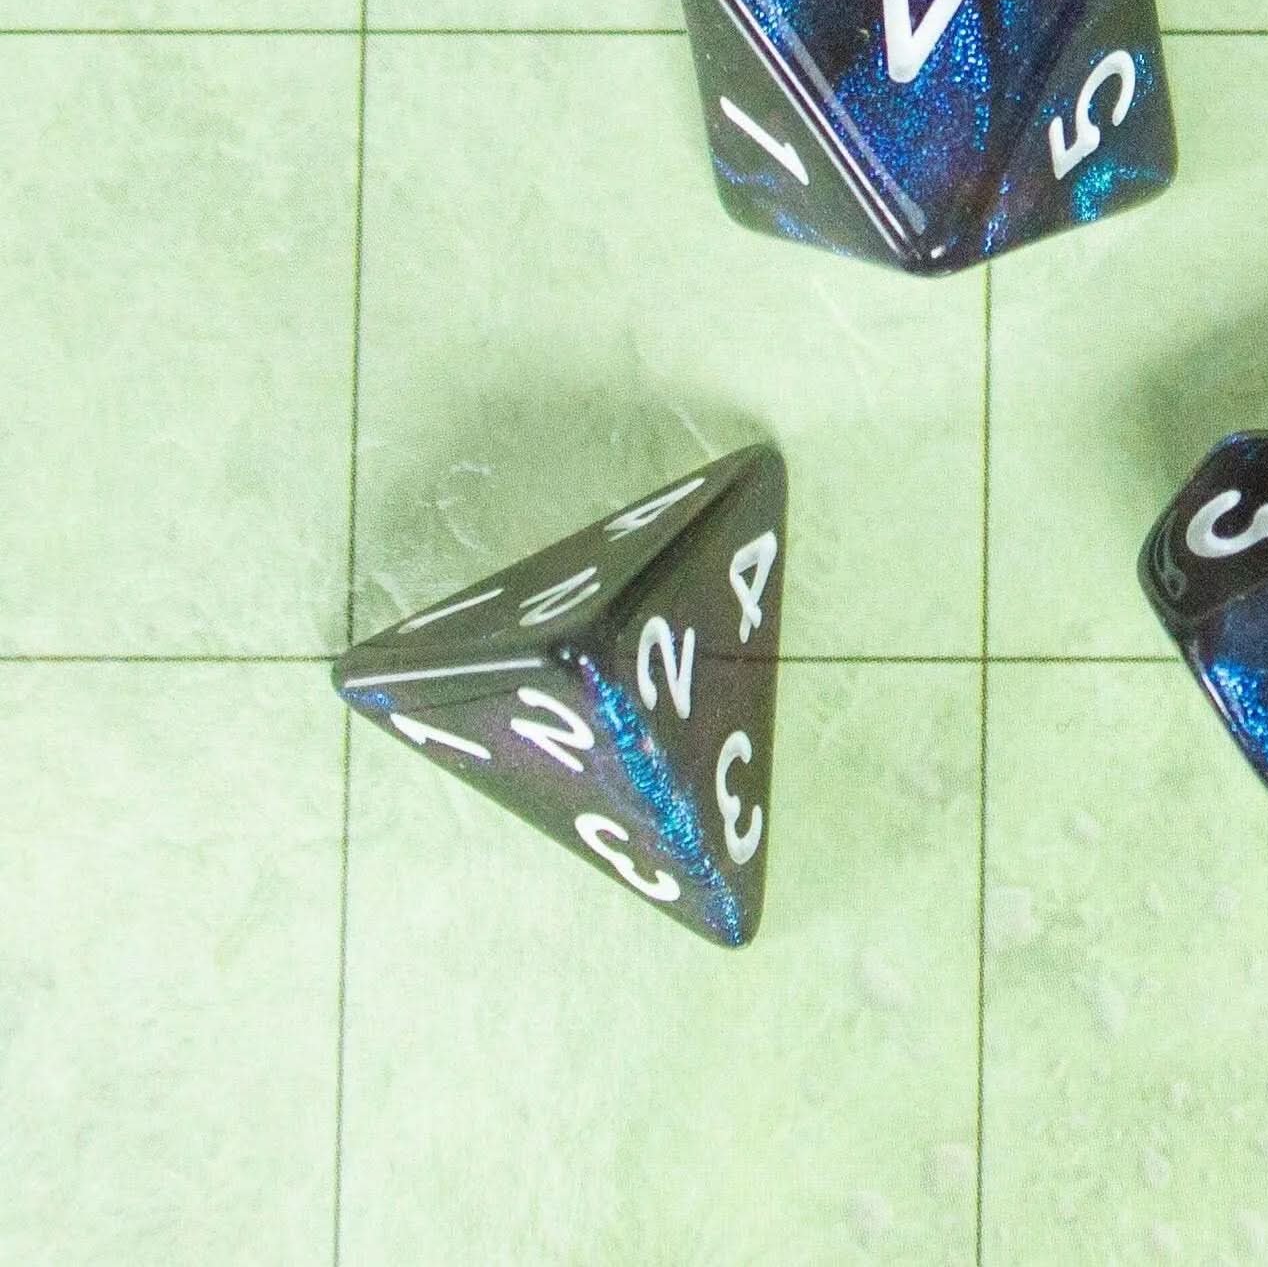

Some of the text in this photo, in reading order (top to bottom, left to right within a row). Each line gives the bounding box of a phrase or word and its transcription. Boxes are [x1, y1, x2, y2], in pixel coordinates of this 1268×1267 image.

[718, 90, 814, 187] 1
[1047, 48, 1137, 182] 5
[727, 528, 780, 646] 4
[634, 613, 697, 723] 2
[386, 710, 494, 764] 1
[506, 685, 597, 777] 2
[714, 729, 764, 867] 3
[570, 810, 683, 906] 3
